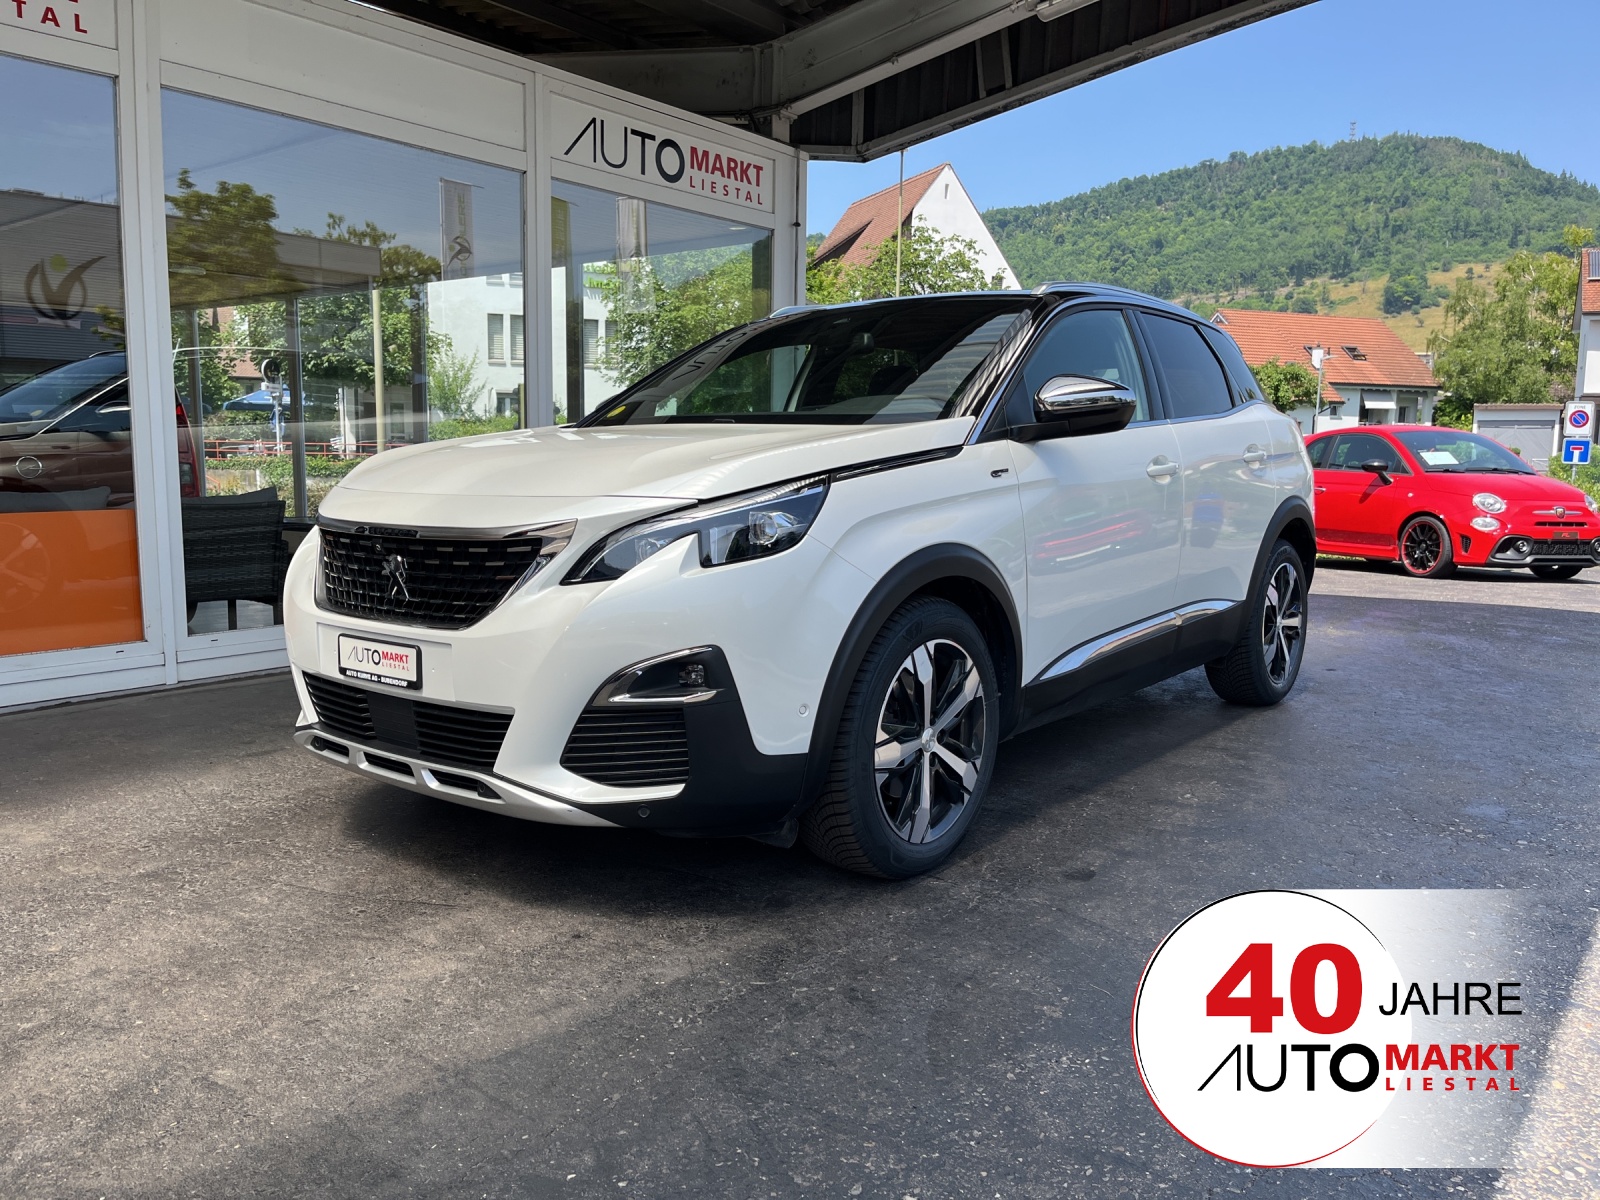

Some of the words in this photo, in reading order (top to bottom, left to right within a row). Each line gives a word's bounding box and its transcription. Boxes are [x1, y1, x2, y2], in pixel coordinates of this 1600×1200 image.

[564, 117, 686, 184] AUTO
[690, 146, 764, 187] MARKT
[690, 176, 763, 205] LIESTAL
[347, 645, 382, 666] AUTO
[381, 650, 409, 665] MARKT
[346, 669, 357, 677] AUTO
[381, 662, 410, 672] LIESTAL
